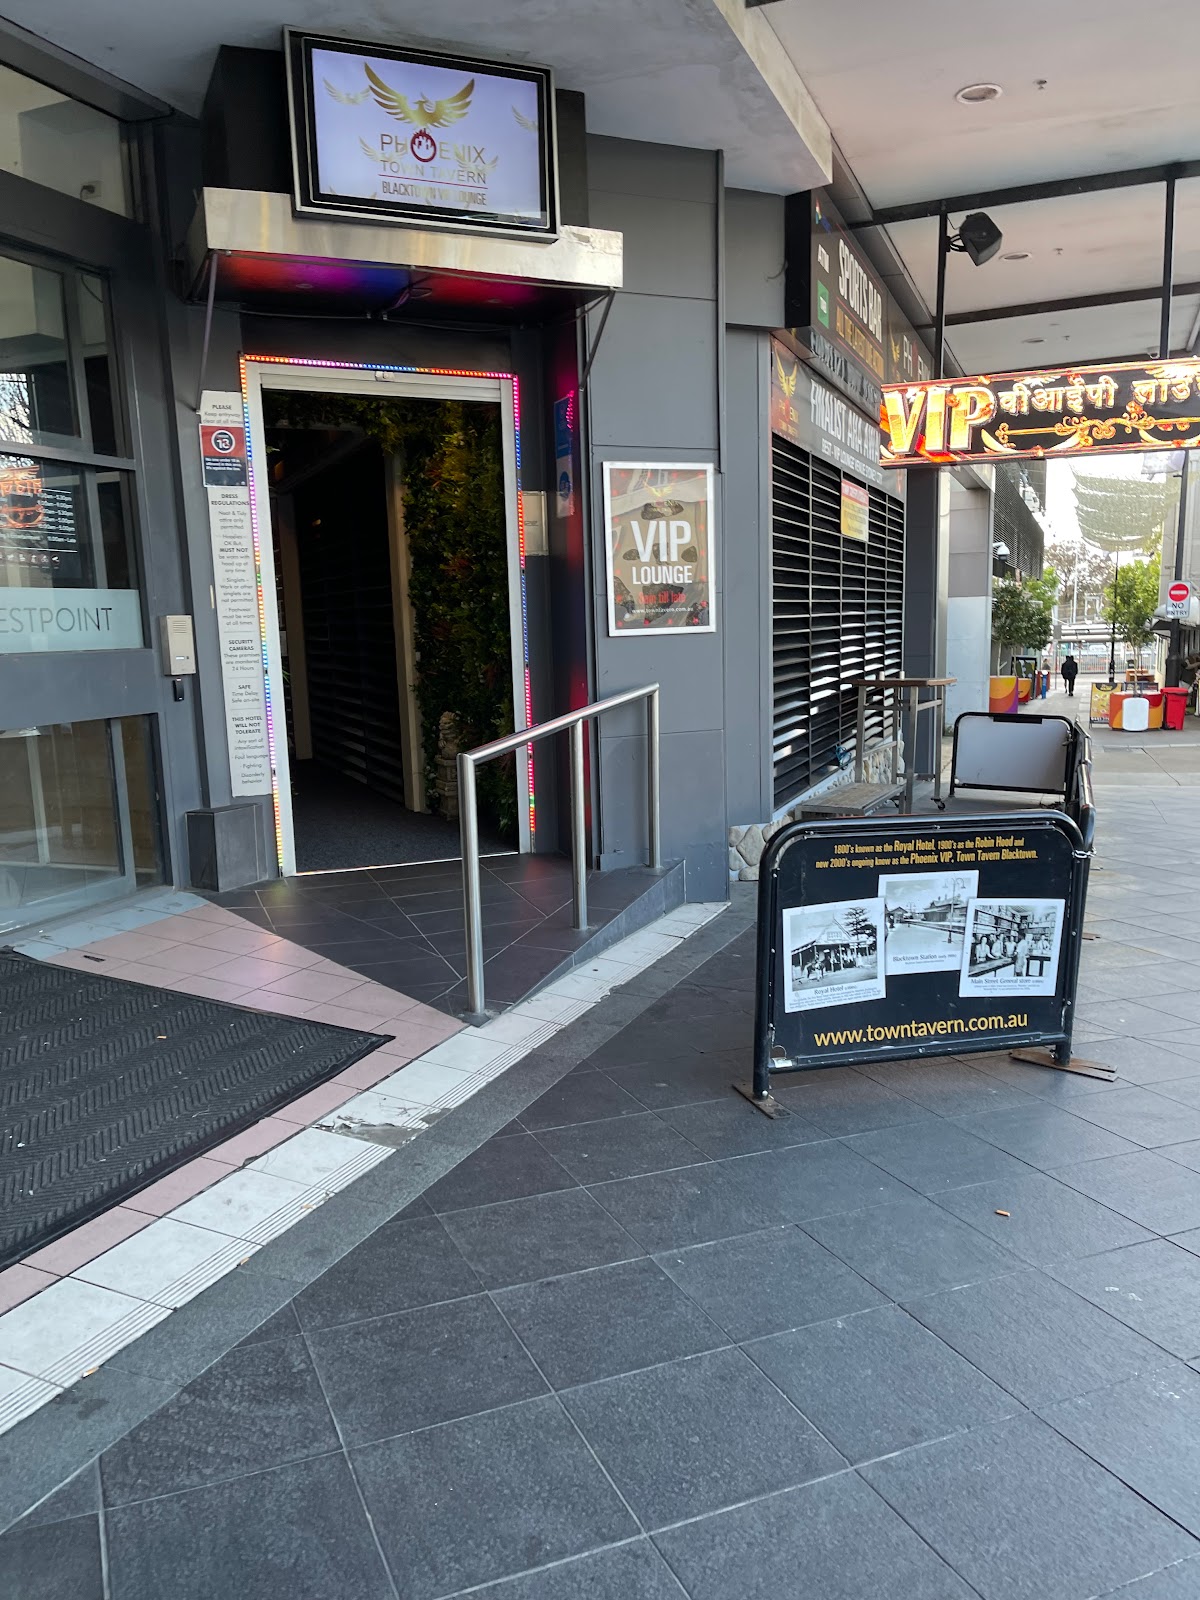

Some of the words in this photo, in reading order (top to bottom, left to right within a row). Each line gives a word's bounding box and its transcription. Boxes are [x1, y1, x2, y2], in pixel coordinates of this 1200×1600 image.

[838, 238, 868, 324] SPORTS
[868, 280, 882, 344] BAR
[998, 375, 1118, 416] वीआईपी
[810, 378, 846, 443] FINALIST
[884, 384, 997, 454] VIP
[216, 439, 230, 448] 18
[840, 450, 854, 470] LOUNGE
[630, 520, 692, 562] VIP
[632, 566, 692, 584] LOUNGE
[834, 844, 854, 854] 1800's
[855, 844, 874, 853] known
[884, 843, 893, 852] the
[894, 840, 914, 853] Royal
[938, 840, 956, 850] 1900's
[965, 840, 974, 848] the
[975, 836, 994, 848] Robin
[996, 836, 1014, 847] Hood
[1014, 837, 1024, 846] and
[830, 858, 850, 868] 2000's
[852, 857, 874, 868] ongoing
[875, 857, 891, 866] know
[900, 856, 909, 864] the
[910, 852, 938, 864] Phoenix
[956, 851, 975, 862] Town
[977, 850, 1000, 861] Tavern
[814, 987, 829, 996] Royal
[814, 1014, 1028, 1046] www.towntavern.com.au
